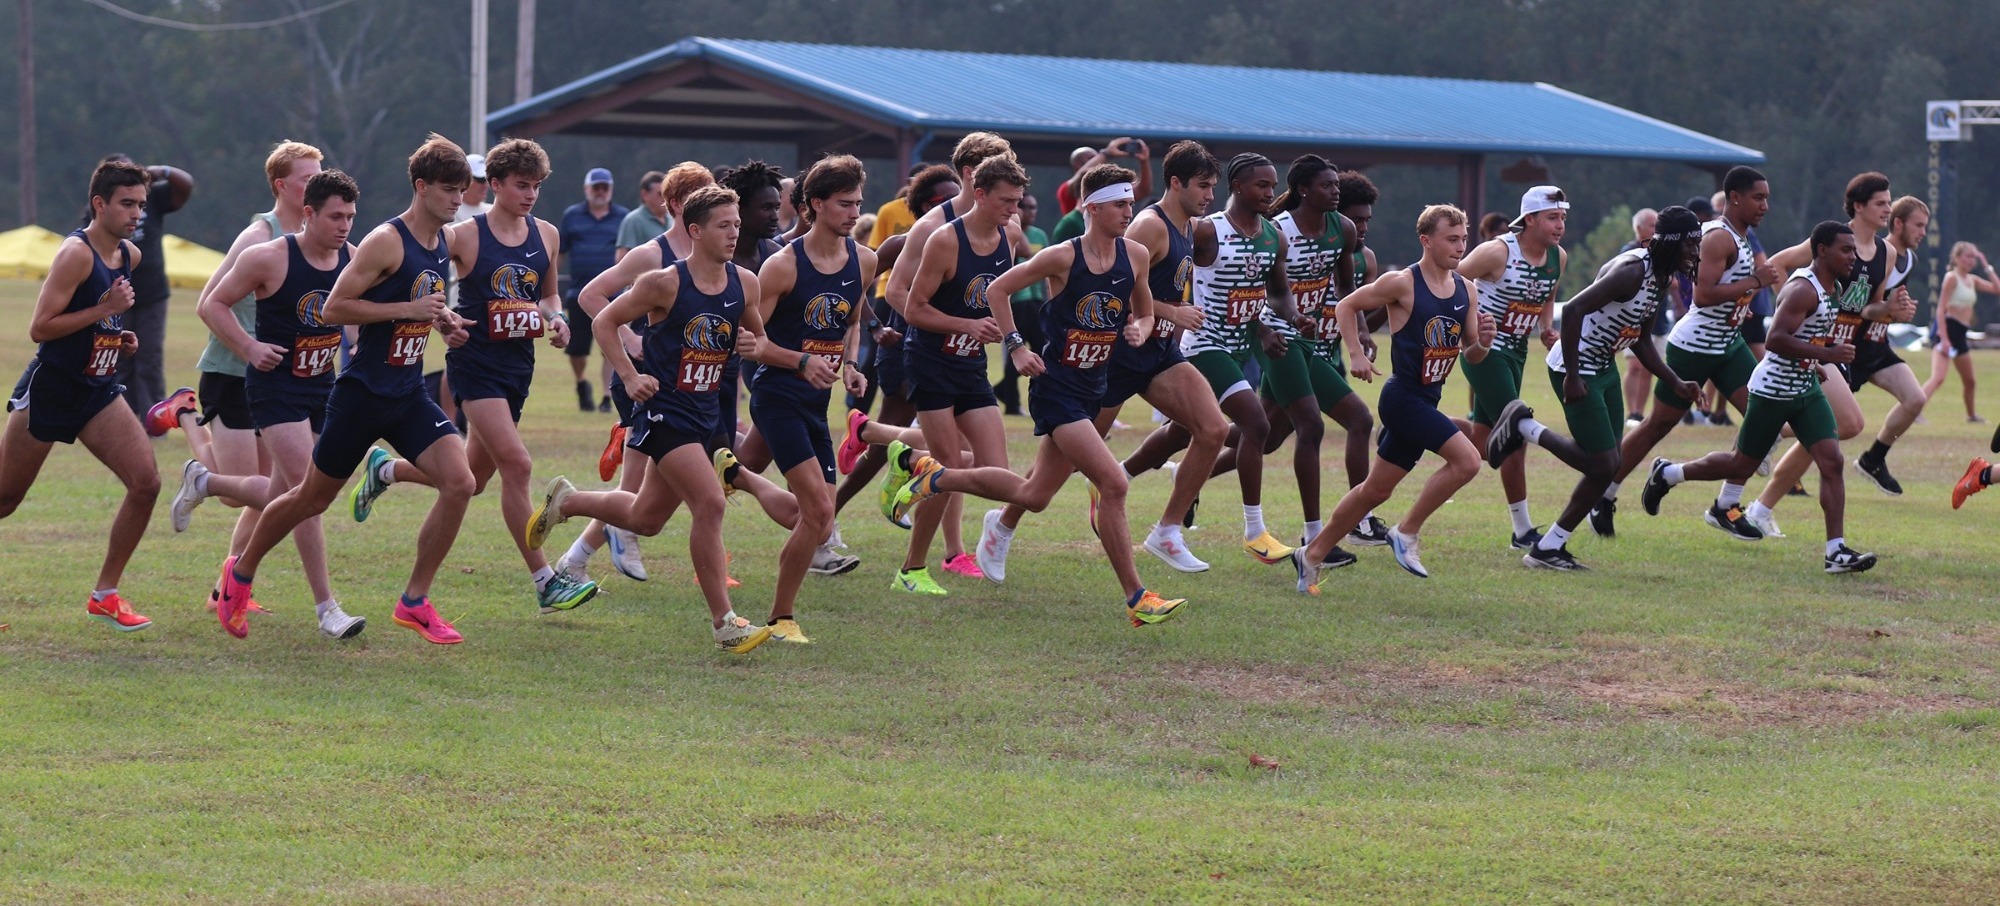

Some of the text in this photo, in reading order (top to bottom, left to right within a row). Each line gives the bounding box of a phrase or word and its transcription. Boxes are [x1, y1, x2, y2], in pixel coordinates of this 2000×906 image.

[1664, 233, 1680, 241] PRO
[1231, 299, 1264, 318] 1439
[493, 311, 541, 332] 1426
[1505, 312, 1539, 329] 1444
[1827, 323, 1855, 339] 1311
[90, 349, 119, 368] 1414
[1067, 343, 1111, 361] 1423
[683, 363, 723, 383] 1416
[1425, 357, 1455, 377] 1417
